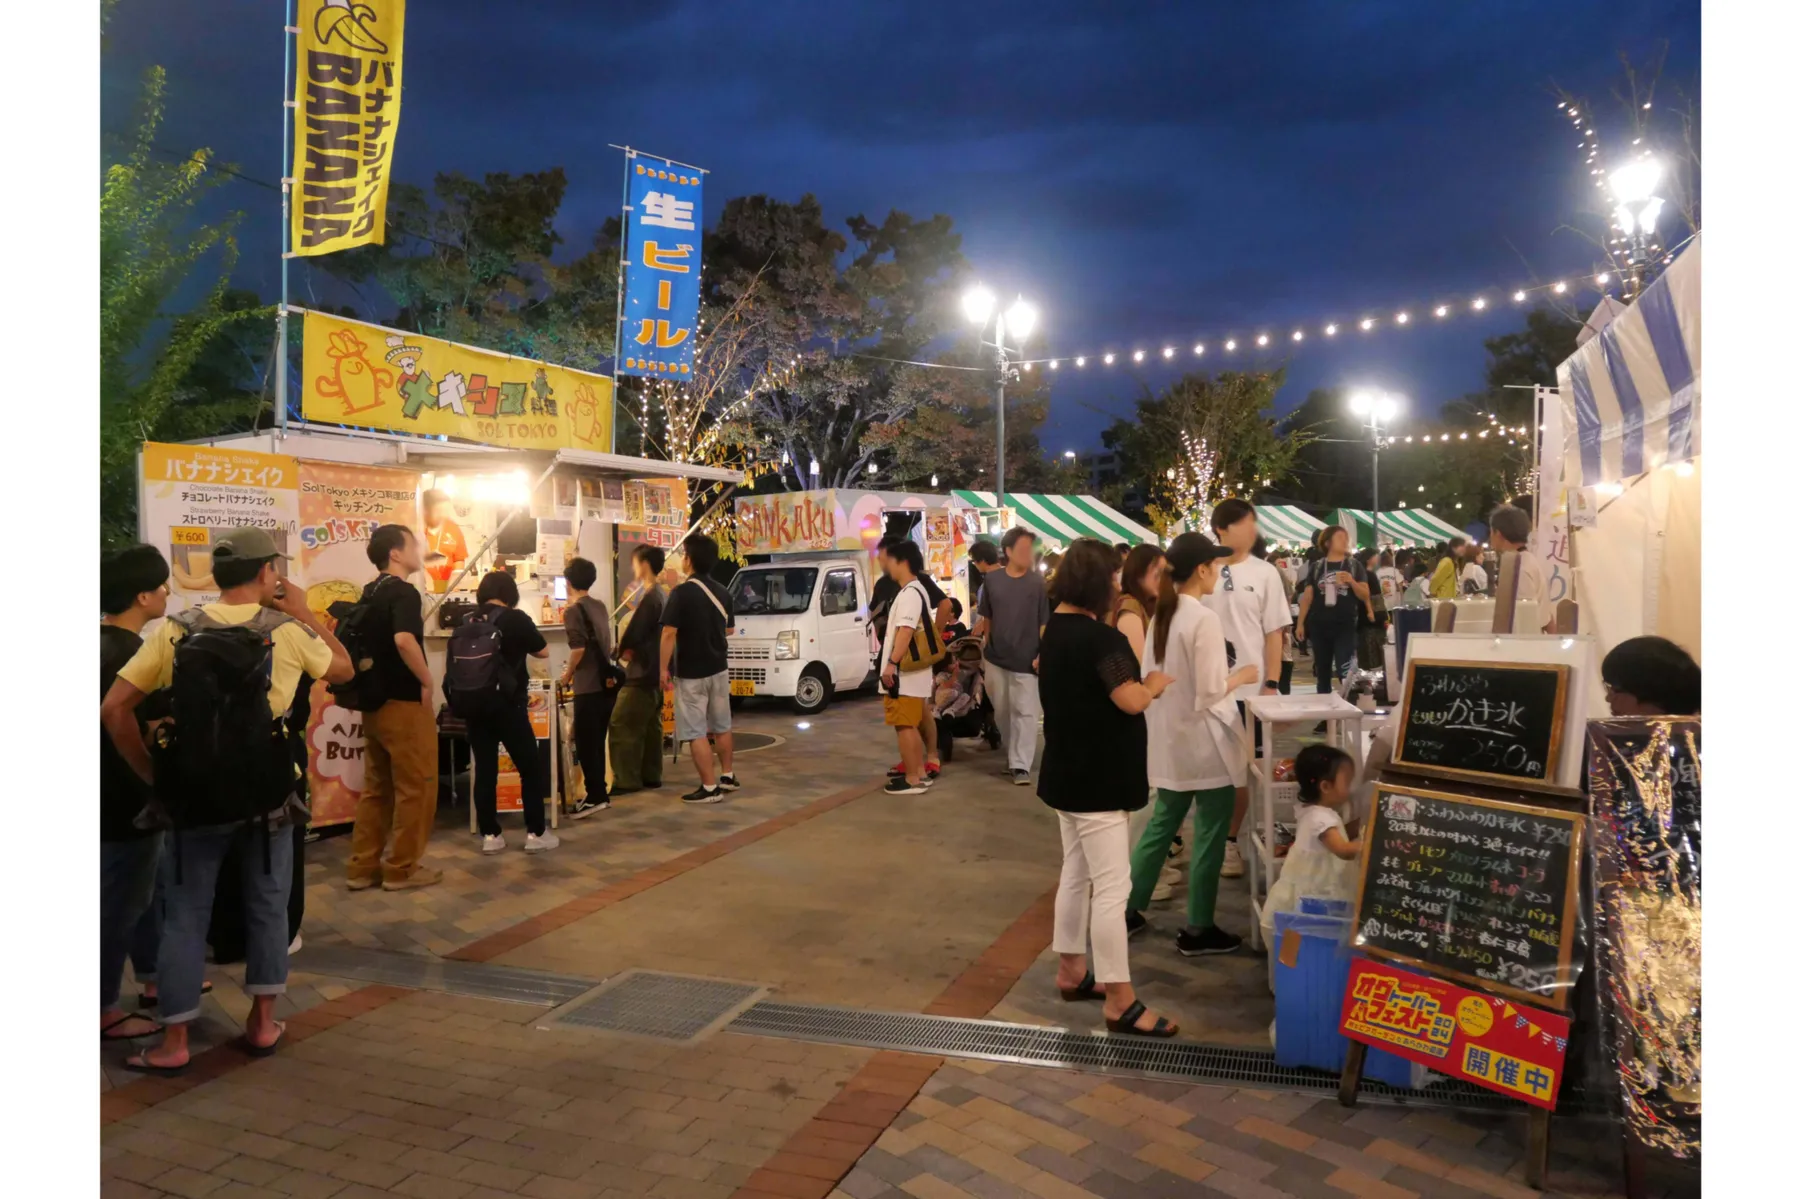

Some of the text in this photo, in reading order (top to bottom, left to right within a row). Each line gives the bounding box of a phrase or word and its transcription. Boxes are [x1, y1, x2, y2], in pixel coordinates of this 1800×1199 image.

[301, 49, 362, 247] BANANA
[352, 59, 395, 239] バナナシェイク
[634, 191, 696, 348] 生ビール
[477, 421, 557, 439] SOL TOKYO
[195, 452, 260, 465] Banana Shake
[166, 459, 284, 487] バナナシェイク
[224, 485, 249, 494] Banana
[249, 486, 268, 495] Shake
[181, 491, 276, 507] チョコレートバナナシェイク
[333, 499, 394, 514] キッチンカー
[189, 506, 271, 517] Strawberry Banana Shake
[182, 514, 277, 528] ストロベリーバナナシェイク
[1466, 1045, 1550, 1095] 開催中
